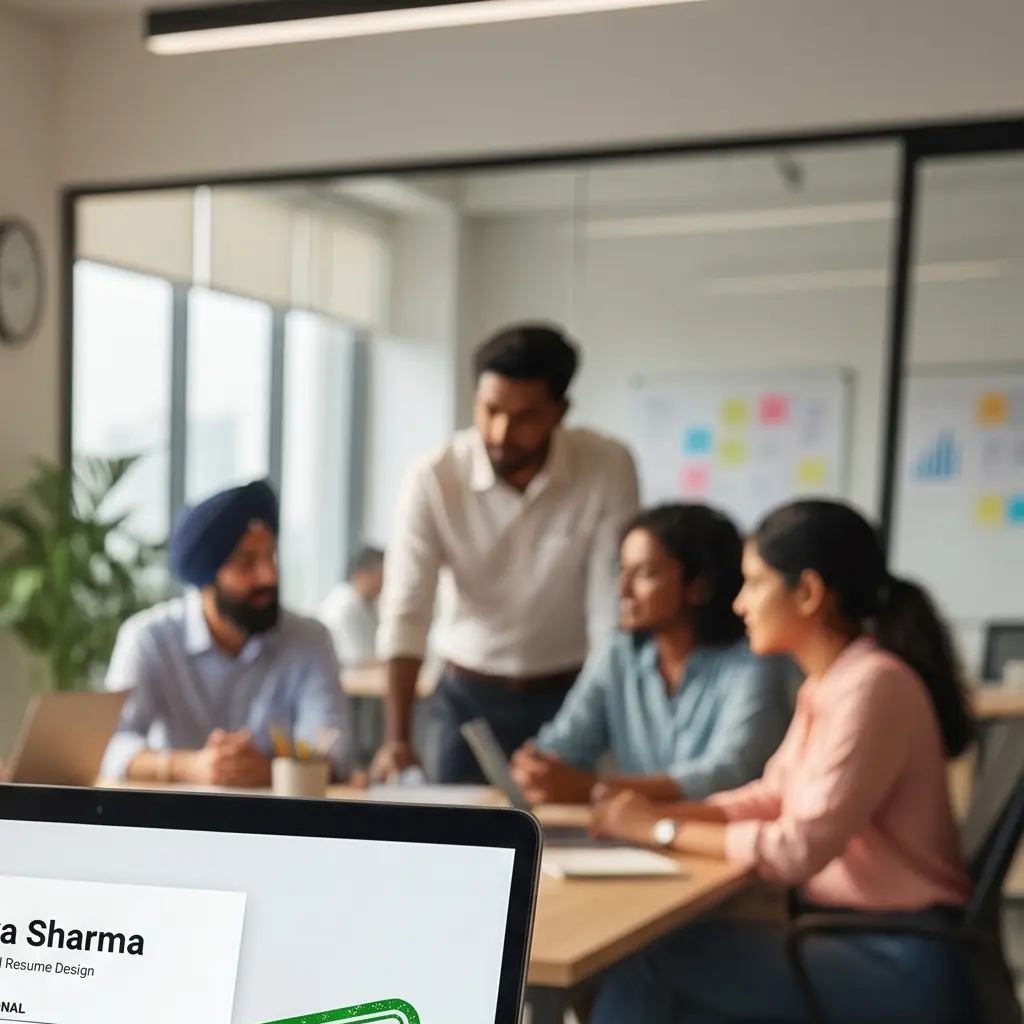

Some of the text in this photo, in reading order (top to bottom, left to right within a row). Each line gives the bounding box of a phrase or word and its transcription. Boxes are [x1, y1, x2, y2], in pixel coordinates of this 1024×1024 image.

[27, 920, 144, 955] Sharma
[6, 958, 52, 972] Resume
[55, 963, 94, 978] Design
